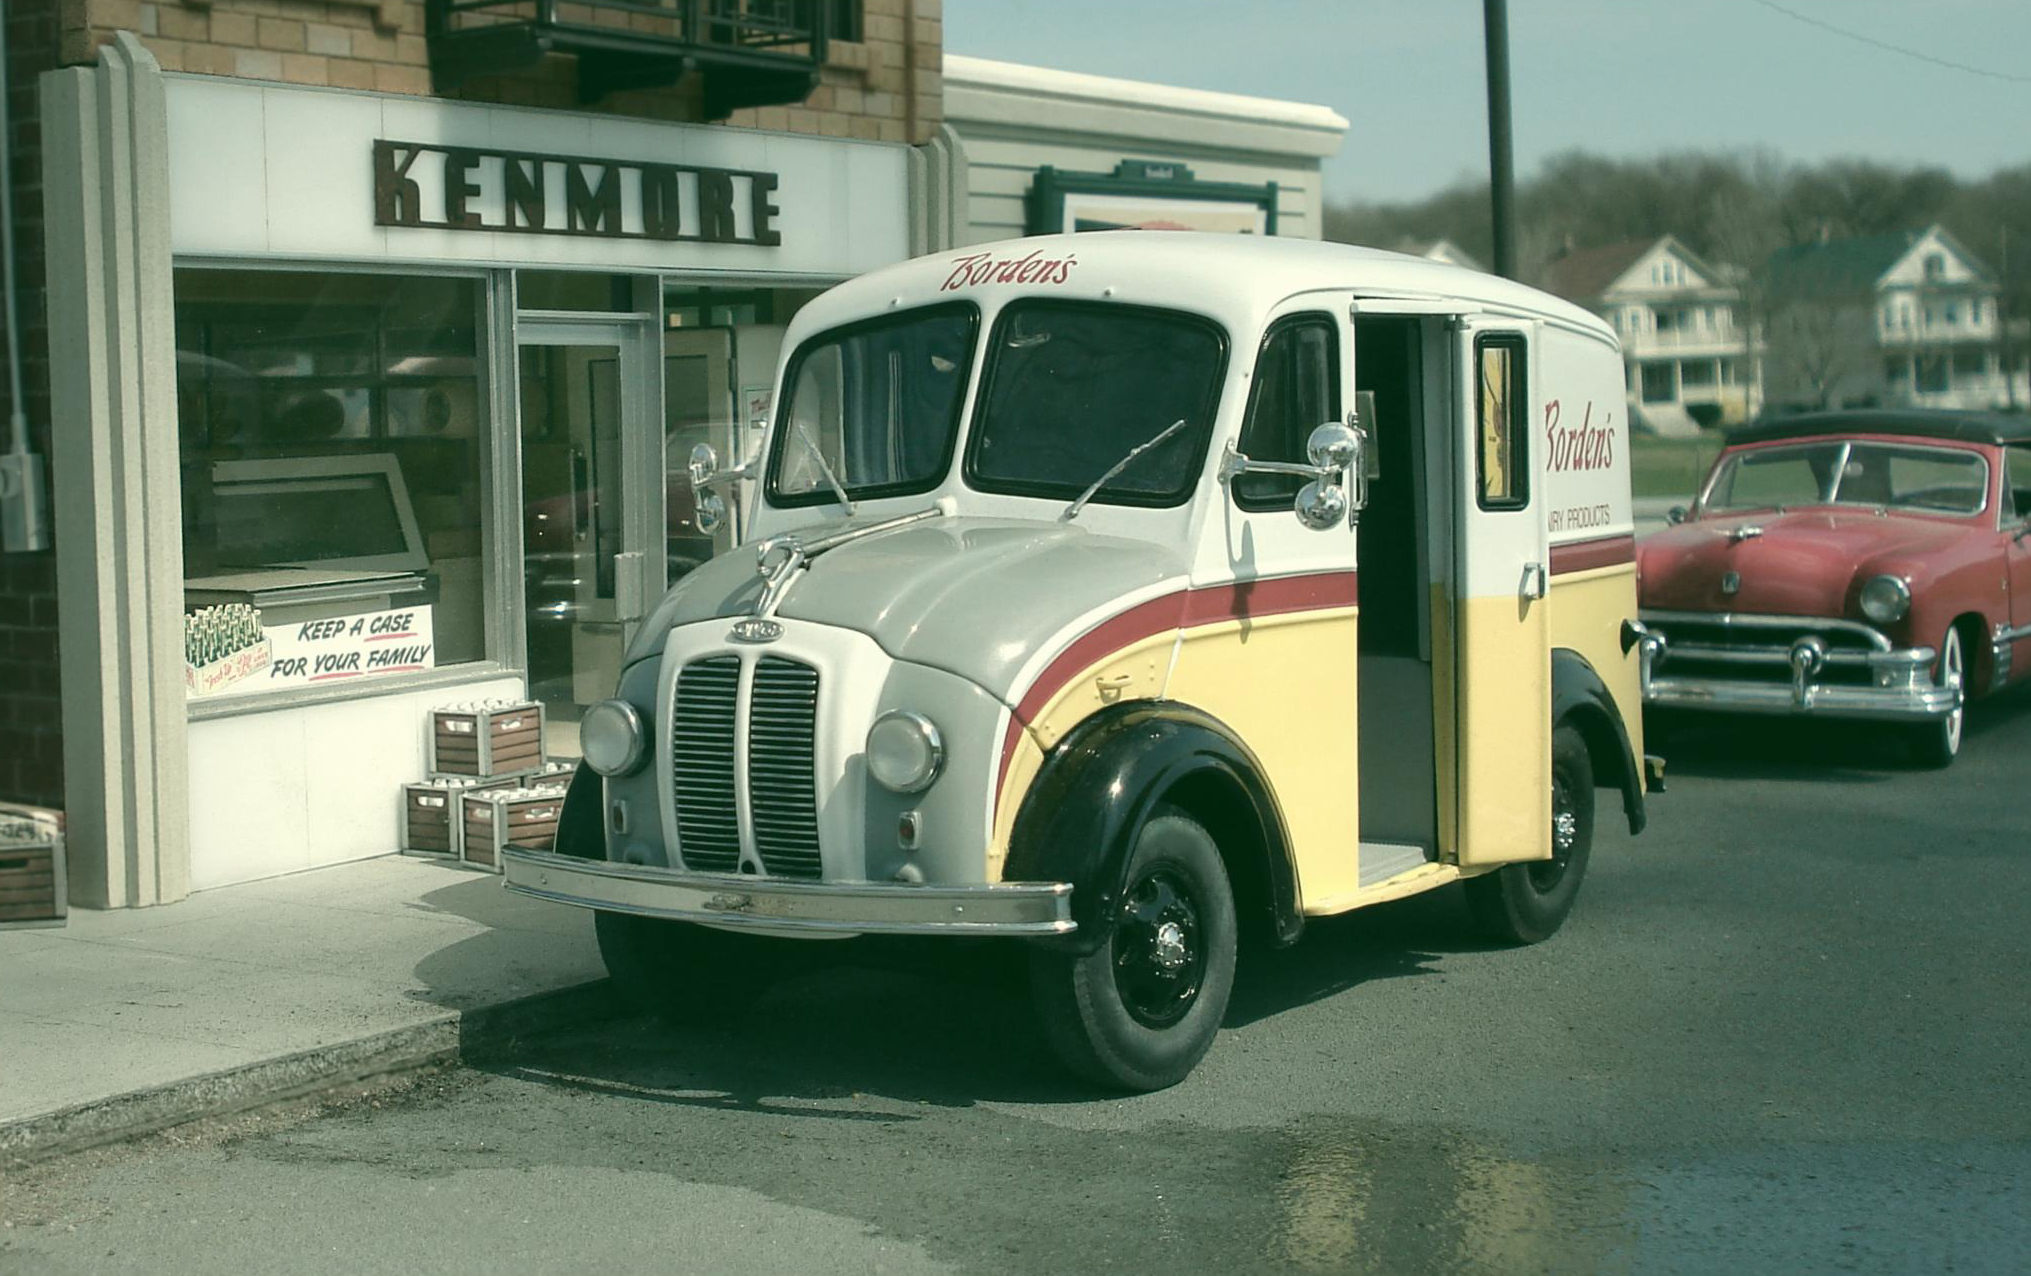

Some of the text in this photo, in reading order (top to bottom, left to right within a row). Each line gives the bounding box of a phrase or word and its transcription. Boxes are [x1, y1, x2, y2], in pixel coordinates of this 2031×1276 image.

[374, 139, 780, 246] KENMORE
[940, 249, 1077, 291] Borden's
[1545, 399, 1615, 472] Borden's
[1568, 503, 1610, 529] PRODUCTS
[298, 613, 414, 642] KEEP A CASE
[271, 657, 307, 678] FOR
[314, 651, 361, 674] YOUR
[367, 644, 431, 668] FAMILY
